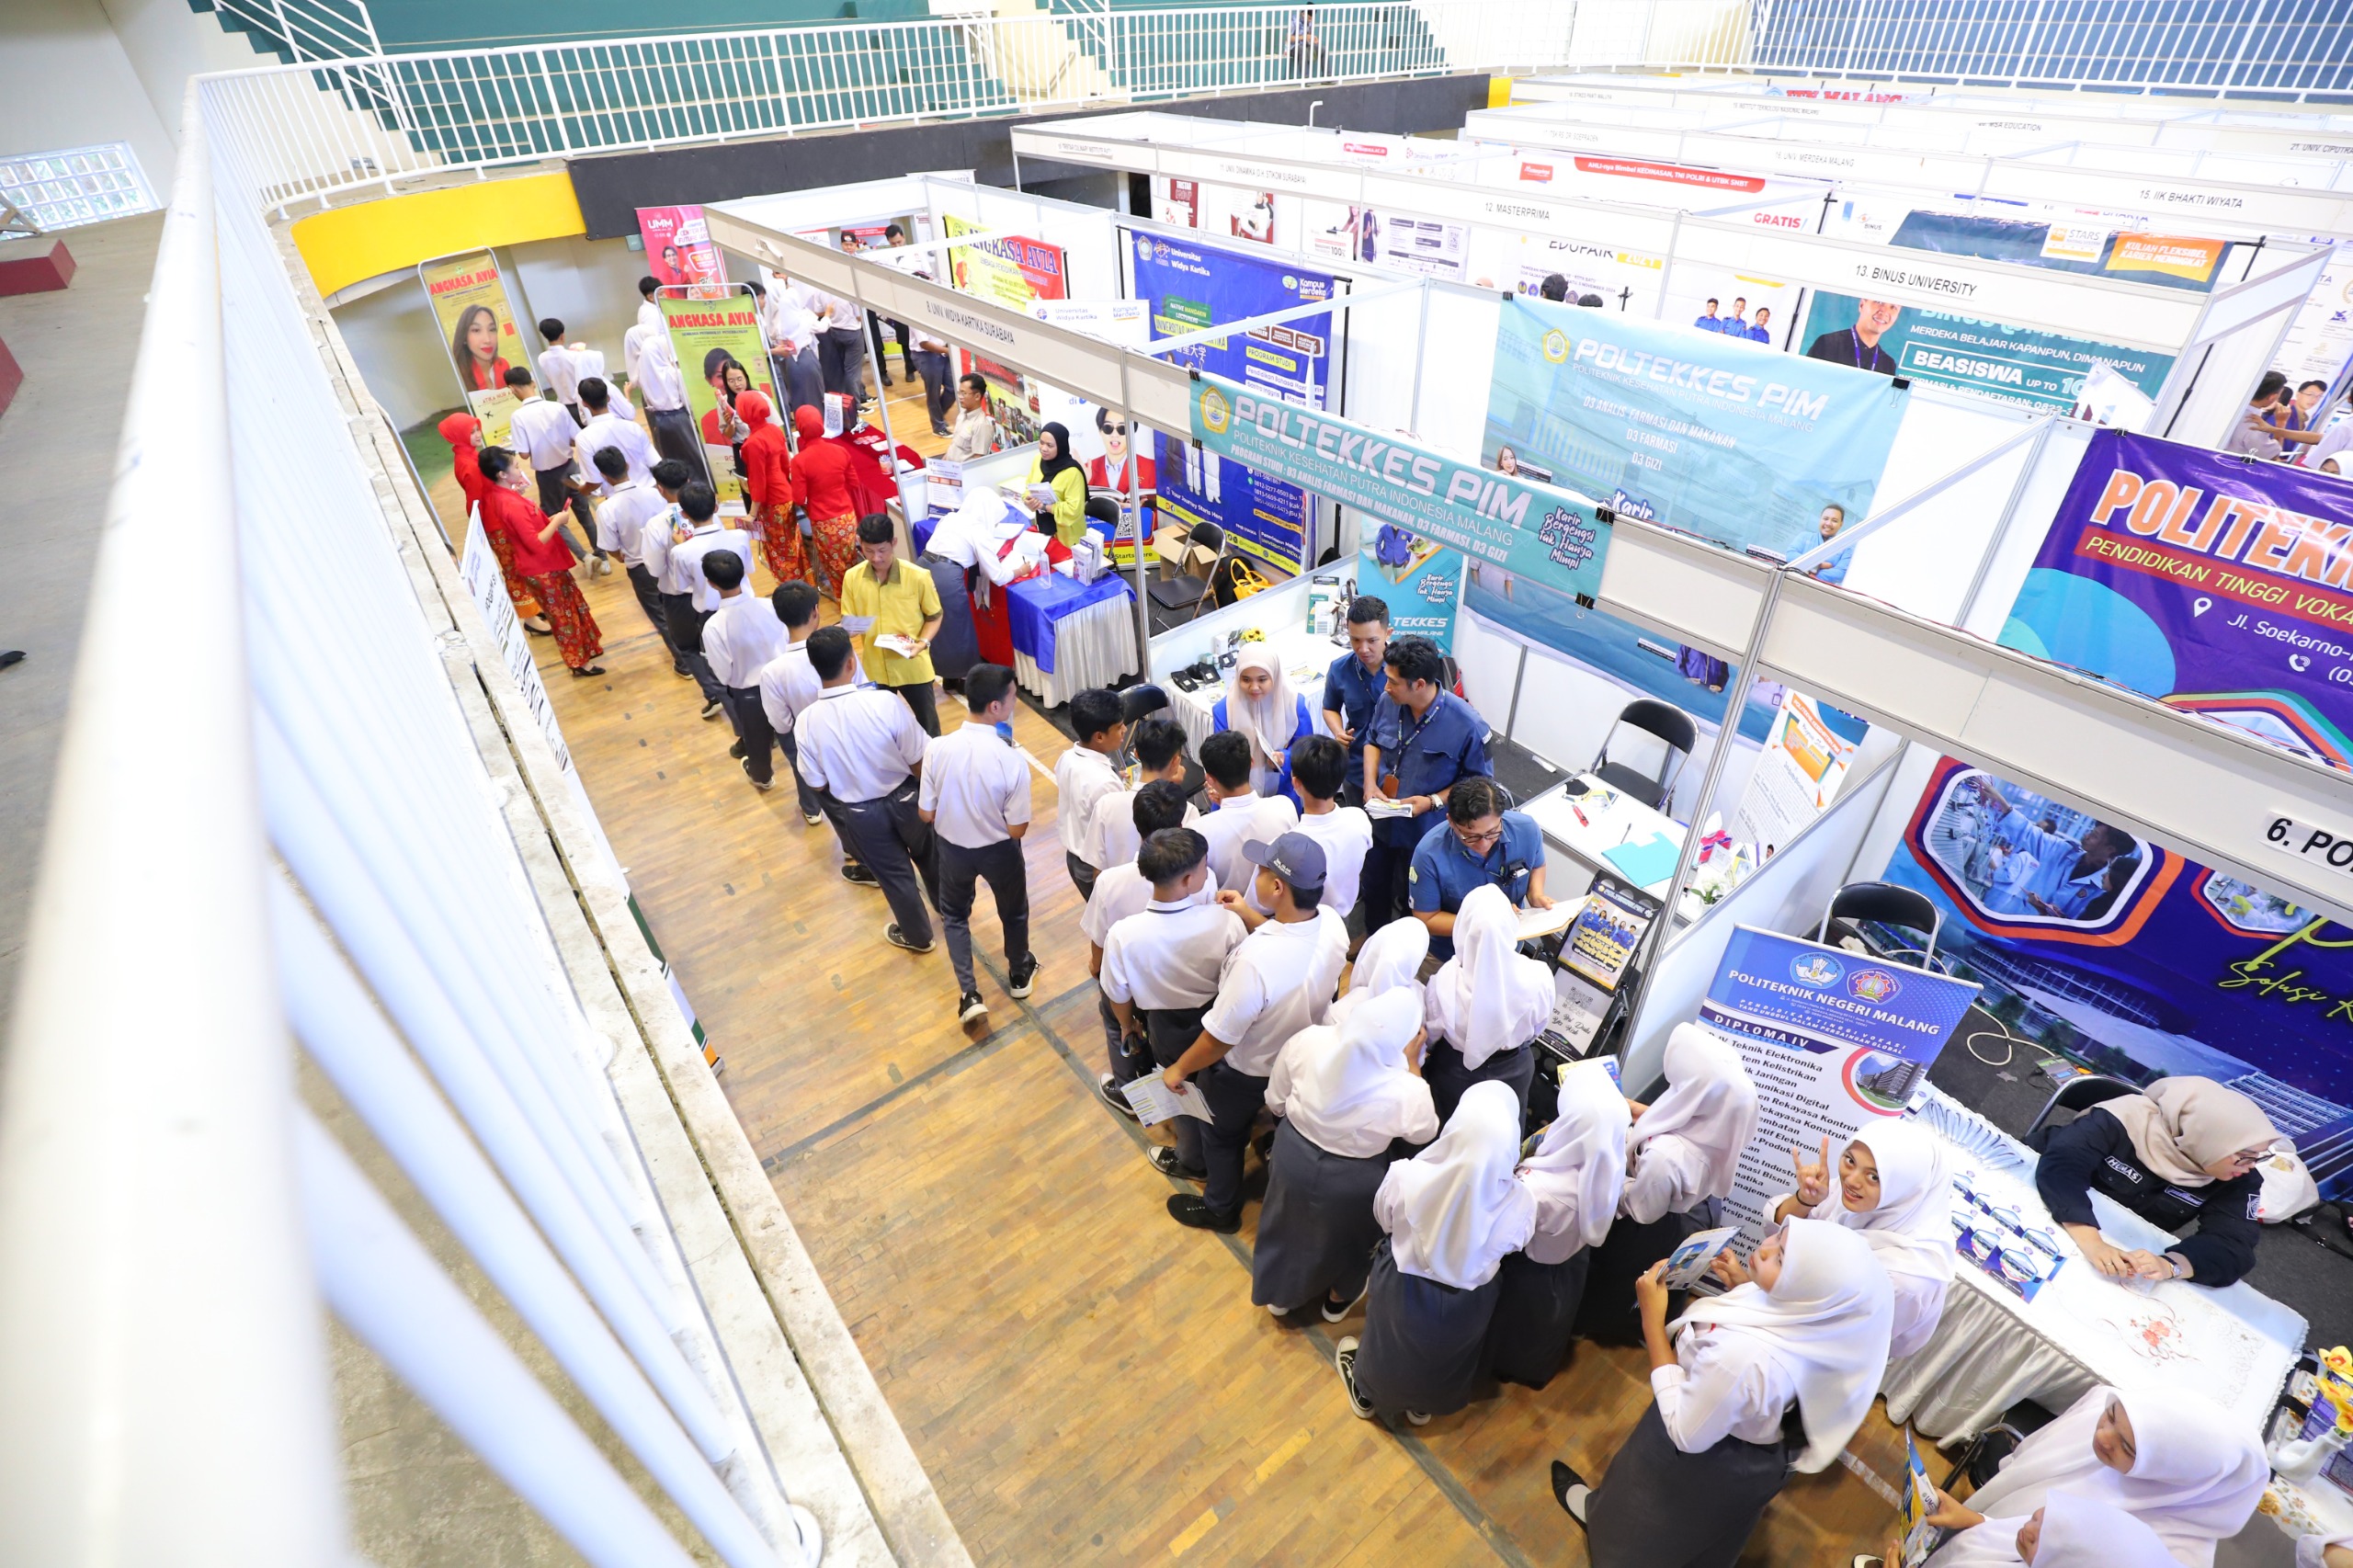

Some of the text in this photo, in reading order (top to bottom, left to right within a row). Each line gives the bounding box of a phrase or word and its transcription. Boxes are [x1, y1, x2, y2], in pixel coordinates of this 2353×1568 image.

[1800, 154, 1827, 165] MERDEKA
[1829, 156, 1855, 167] MALANG
[1616, 165, 1636, 173] Bimbel
[1686, 173, 1705, 182] POLRI
[1711, 176, 1729, 186] UTBK
[1730, 178, 1748, 187] SNBT
[2140, 190, 2243, 209] 15. IIK BHAKTI WIYATA
[1485, 202, 1550, 221] 12. MASTERPRIMA
[1754, 212, 1802, 229] GRATIS
[647, 219, 673, 229] UMM
[2068, 230, 2101, 241] STARS
[1171, 248, 1202, 263] Universitas
[2120, 250, 2208, 268] KARIER MENINGKAT
[2125, 241, 2208, 259] KULIAH FLEKSIBEL
[1171, 259, 1210, 277] Widya Kartika
[429, 274, 474, 296] ANGKASA
[1300, 278, 1325, 289] Kampus
[1300, 286, 1326, 296] Merdeka
[1857, 265, 1977, 296] 13. BINUS UNIVERSITY
[669, 312, 756, 328] ANGKASA AVIA
[945, 306, 960, 324] WIDYA
[961, 311, 984, 334] KARTIKA
[985, 322, 1015, 346] SURABAYA
[1248, 347, 1290, 367] PROGRAM STUDI
[1910, 324, 1958, 341] MERDEKA
[1960, 334, 2007, 349] BELAJAR
[2009, 341, 2071, 360] KAPANPUN,
[2073, 353, 2145, 373] DIMANAPUN
[1248, 368, 1294, 388] Pendidikan Bahasa
[1574, 337, 1830, 421] POLTEKKES PIM
[1913, 349, 2057, 392] BEASISWA UP TO
[1247, 382, 1280, 399] Sastra Inggris
[1573, 363, 1814, 433] POLITEKNIK KESEHATAN PUTRA INDONESIA MALANG
[1583, 395, 1737, 449] D3 ANALIS FARMASI DAN MAKANAN
[1627, 428, 1678, 454] D3 FARMASI
[1233, 395, 1532, 530] POLTEKKES PIM
[1632, 452, 1662, 472] D3 GIZI
[1234, 430, 1288, 461] POLITEKNIK
[1290, 451, 1347, 481] KESEHATAN
[1351, 476, 1388, 497] PUTRA
[1390, 489, 1457, 524] INDONESIA
[1458, 517, 1513, 546] MALANG
[1232, 445, 1263, 467] PROGRAM
[1263, 456, 1283, 473] STUDI
[1287, 466, 1298, 479] D3
[1298, 469, 1323, 487] ANALIS
[1324, 478, 1357, 502] FARMASI
[1357, 491, 1373, 507] DAN
[1374, 496, 1415, 528] MAKANAN,
[1417, 517, 1428, 531] D3
[1430, 523, 1471, 550] FARMASI,
[1472, 540, 1485, 553] D3
[1487, 544, 1508, 563] GIZI
[1555, 507, 1581, 525] Karir
[1545, 514, 1595, 544] Bergengsi
[1539, 529, 1592, 559] tak Hanya
[1550, 550, 1581, 570] Mimpi
[2086, 537, 2290, 605] PENDIDIKAN TINGGI
[2227, 614, 2248, 631] Jl.
[2267, 817, 2292, 846] 6.
[2219, 961, 2327, 1003] Solusi
[1728, 970, 1813, 1000] POLITEKNIK
[1816, 993, 1871, 1017] NEGERI
[1873, 1009, 1941, 1036] MALANG
[1715, 1015, 1810, 1048] DIPLOMA IV
[1739, 1004, 1759, 1015] YANG
[1759, 1008, 1789, 1022] UNGGUL
[1790, 1017, 1818, 1028] DALAM
[1820, 1026, 1871, 1044] PERSAINGAN
[1871, 1040, 1903, 1055] GLOBAL
[1740, 999, 1812, 1022] PENDIDIKAN
[1817, 1019, 1858, 1035] TINGGI
[1862, 1033, 1906, 1050] VOKASI
[1732, 1040, 1824, 1073] Teknik Elektronika
[1755, 1070, 1798, 1088] Jaringan
[1763, 1060, 1816, 1083] Kelistrikan
[1772, 1097, 1818, 1119] Rekayasa
[1796, 1094, 1829, 1111] Digital
[1759, 1117, 1800, 1135] embatan
[1763, 1171, 1790, 1187] Bisnis
[2108, 1159, 2139, 1181] HUMAS
[1722, 1206, 1762, 1226] Arsip dan
